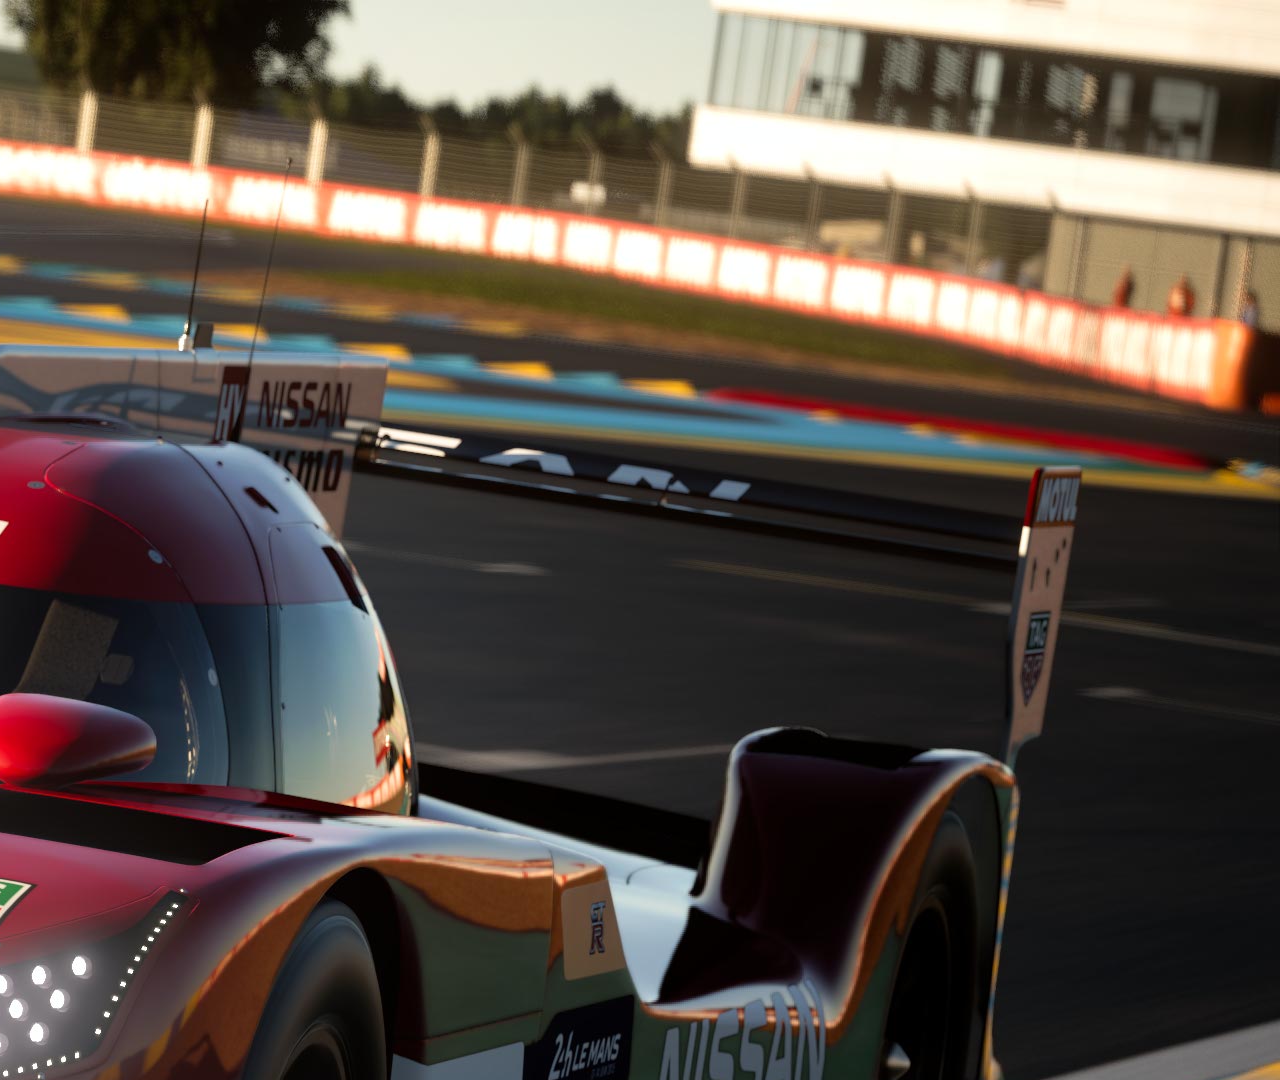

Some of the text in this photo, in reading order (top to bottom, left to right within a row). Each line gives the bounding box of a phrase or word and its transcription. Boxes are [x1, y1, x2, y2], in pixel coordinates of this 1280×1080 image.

[257, 381, 352, 428] NISSAN
[1037, 478, 1080, 522] MOTUL
[571, 1041, 590, 1072] LE
[587, 1033, 622, 1069] MANS
